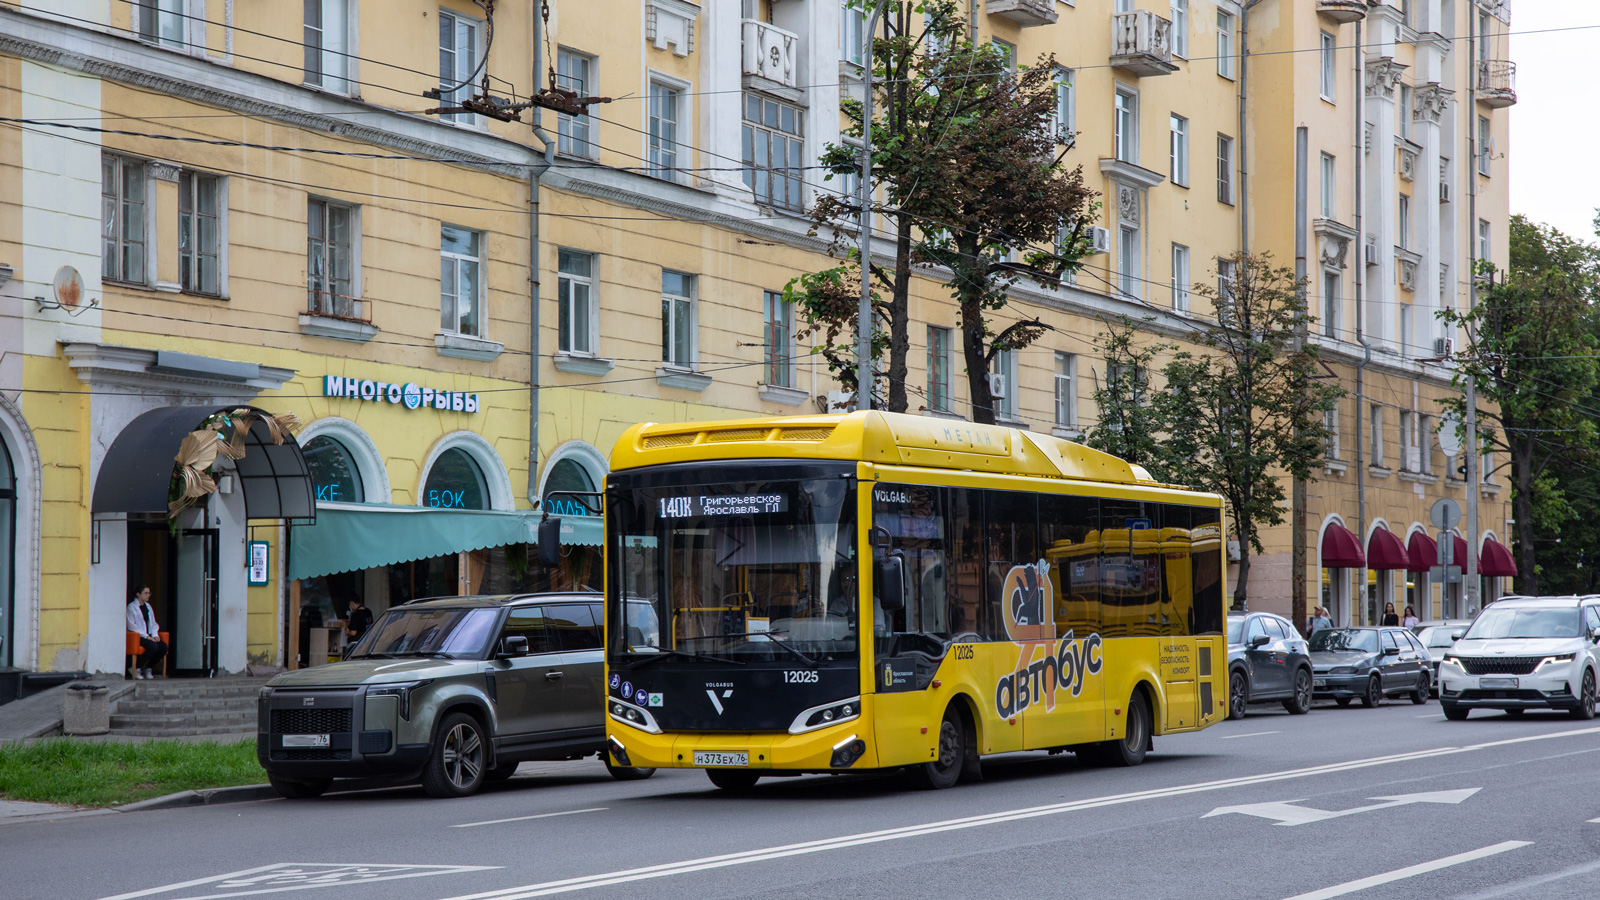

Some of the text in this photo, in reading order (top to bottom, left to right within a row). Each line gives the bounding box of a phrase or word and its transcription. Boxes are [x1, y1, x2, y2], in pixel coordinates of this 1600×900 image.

[324, 375, 480, 413] МНОГО РЫБЫ
[943, 427, 991, 445] МЕТАН
[429, 489, 465, 508] ВОК
[660, 495, 782, 518] 140К Григорьевское
[541, 499, 586, 517] ОЛЛЫ
[703, 503, 779, 516] Ярославль ГЛ
[953, 645, 974, 661] 12025
[783, 670, 819, 683] 12025
[996, 629, 1103, 721] автобус
[1172, 666, 1190, 675] КОМФОРТ
[319, 735, 328, 743] 76
[736, 753, 746, 762] 76
